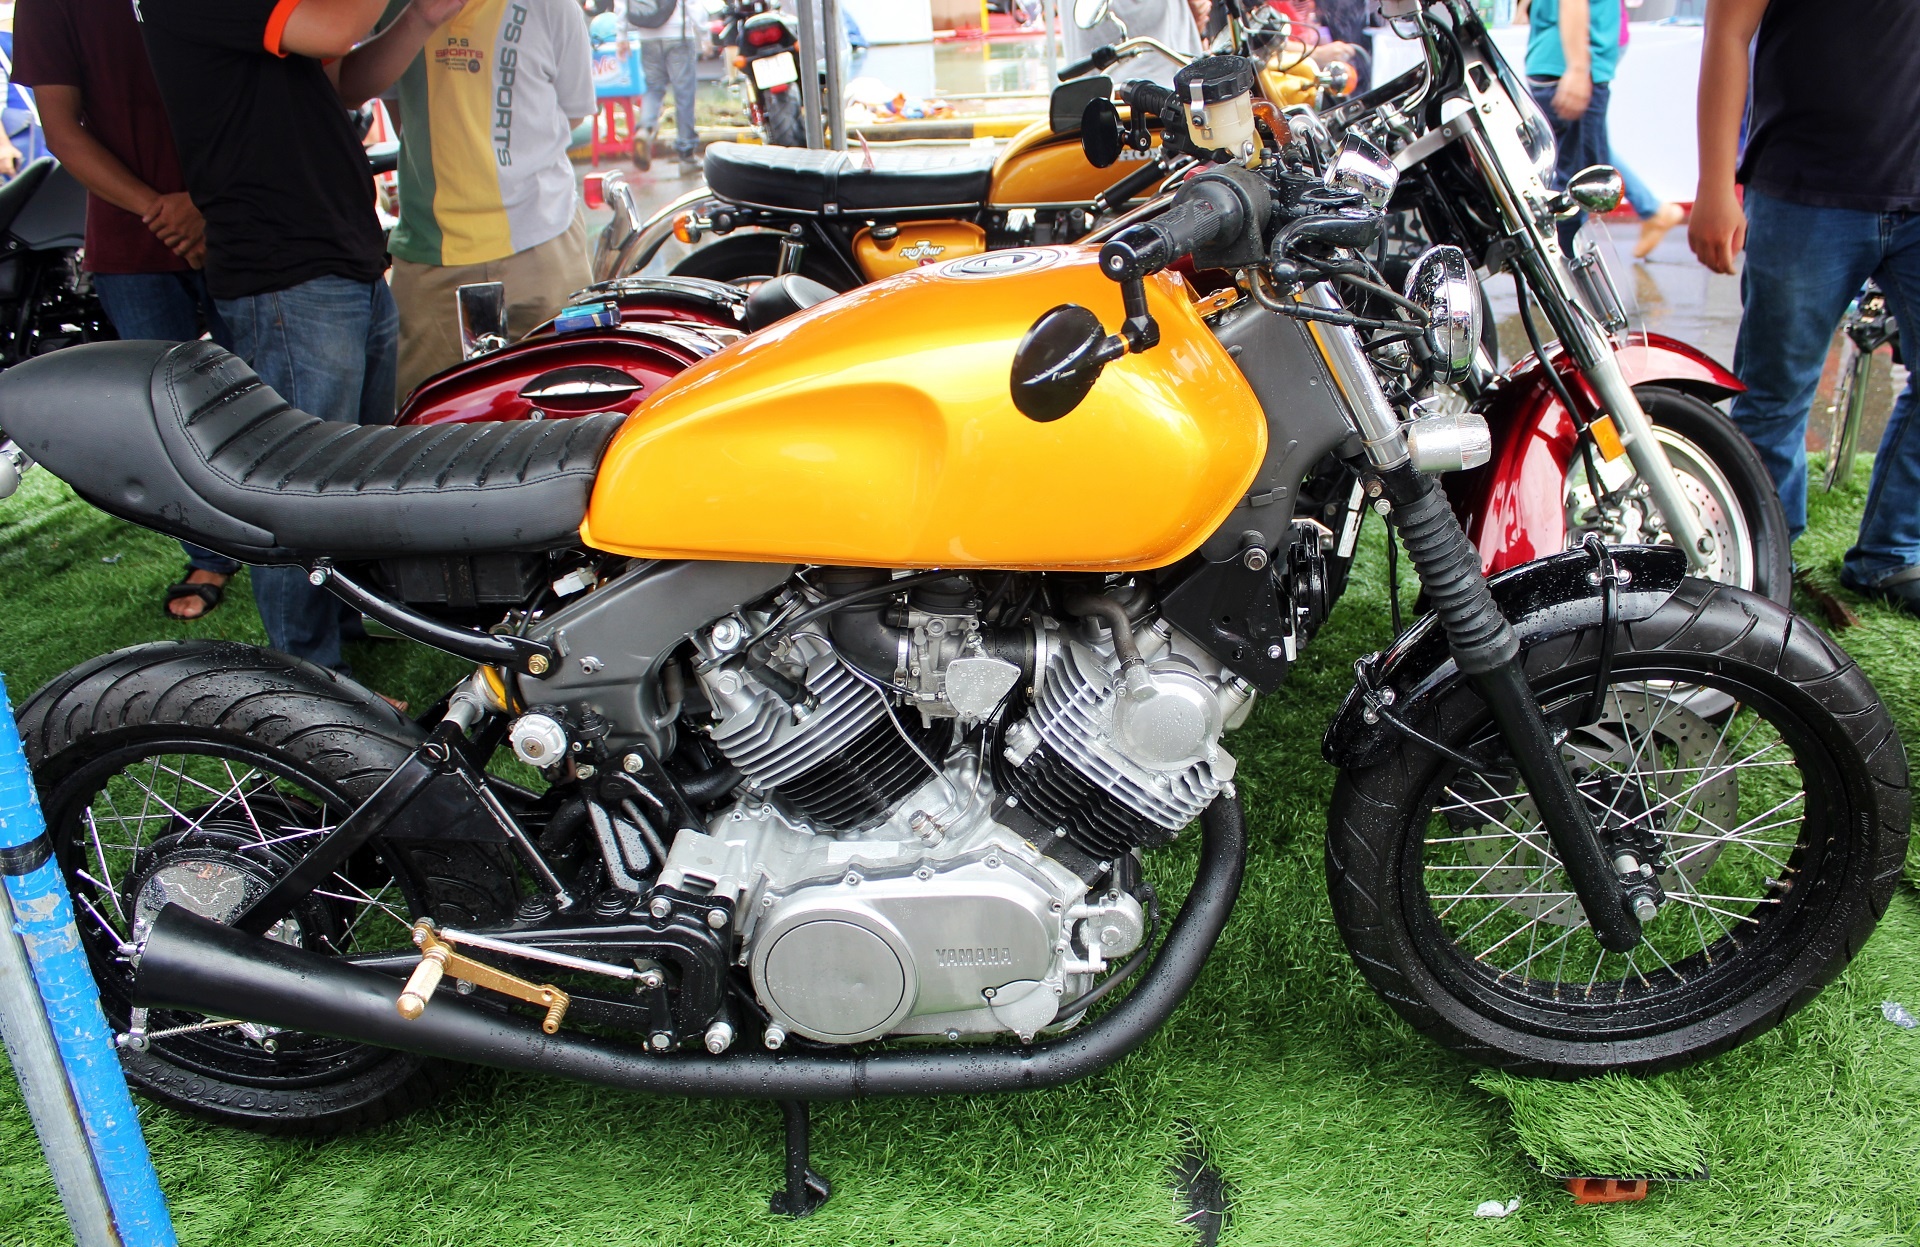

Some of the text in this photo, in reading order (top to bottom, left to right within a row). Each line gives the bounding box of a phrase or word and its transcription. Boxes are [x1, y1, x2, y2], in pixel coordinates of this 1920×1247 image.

[447, 37, 469, 47] P.S
[435, 48, 484, 59] SPORTS
[493, 4, 527, 167] PS SPORTS
[936, 947, 1012, 967] YAMAHA
